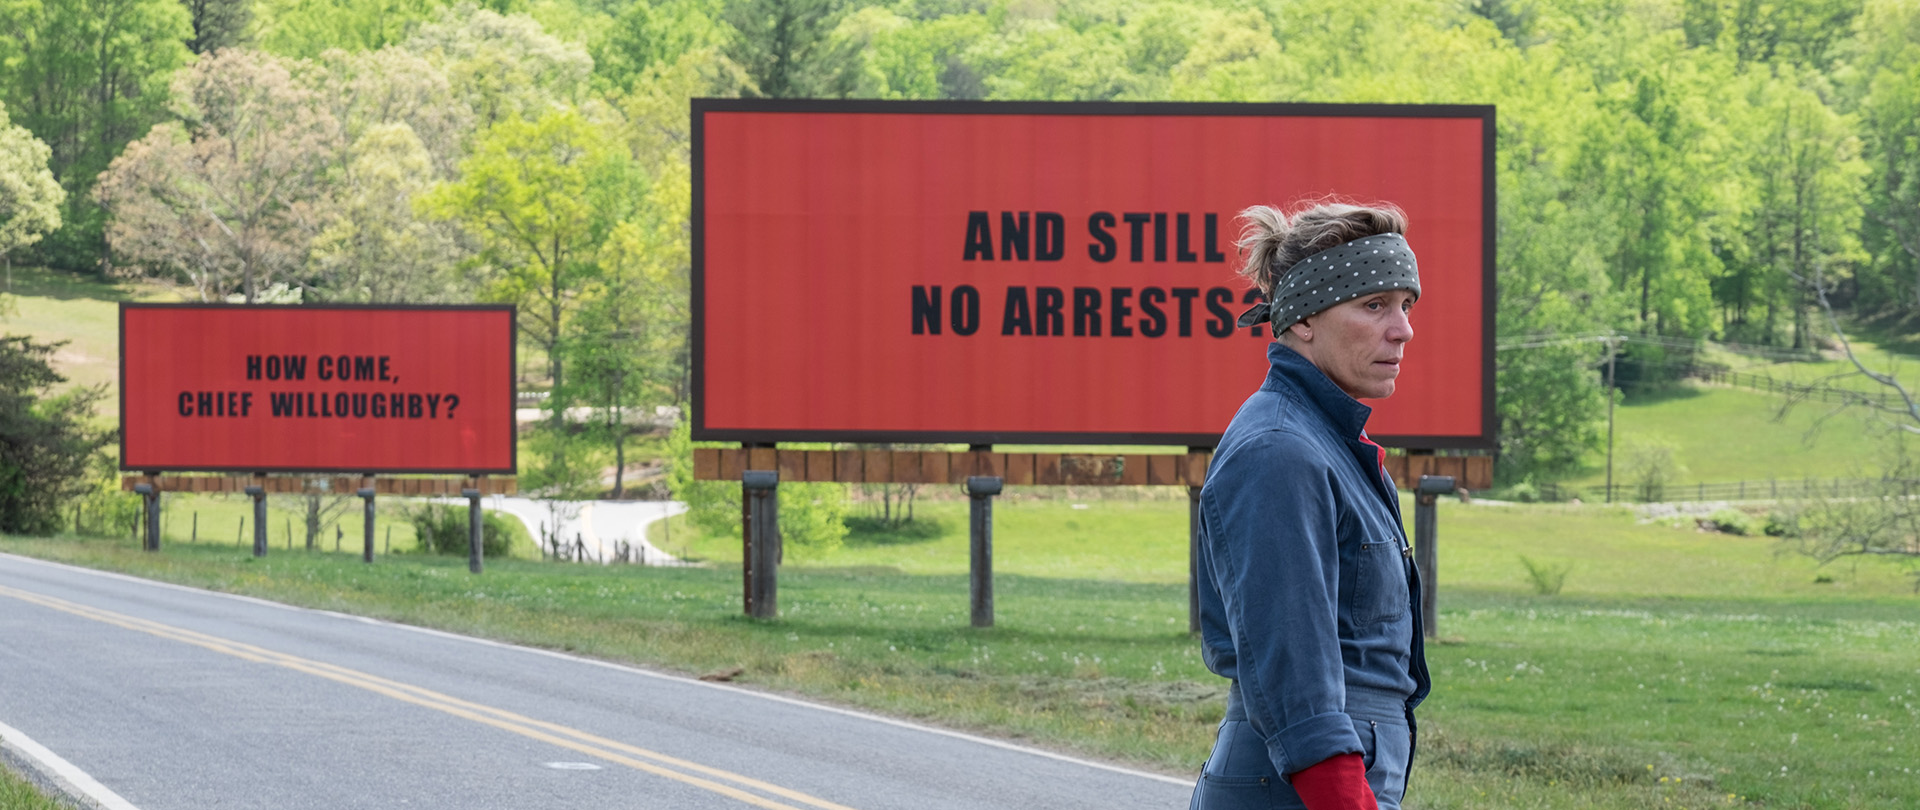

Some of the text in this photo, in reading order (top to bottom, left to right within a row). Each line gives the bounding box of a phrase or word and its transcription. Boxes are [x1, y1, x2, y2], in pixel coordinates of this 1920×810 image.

[963, 211, 1226, 263] AND STILL
[911, 285, 980, 337] NO
[246, 355, 400, 385] HOW COME,
[178, 391, 460, 420] CHIEF WILLOUGHBY?
